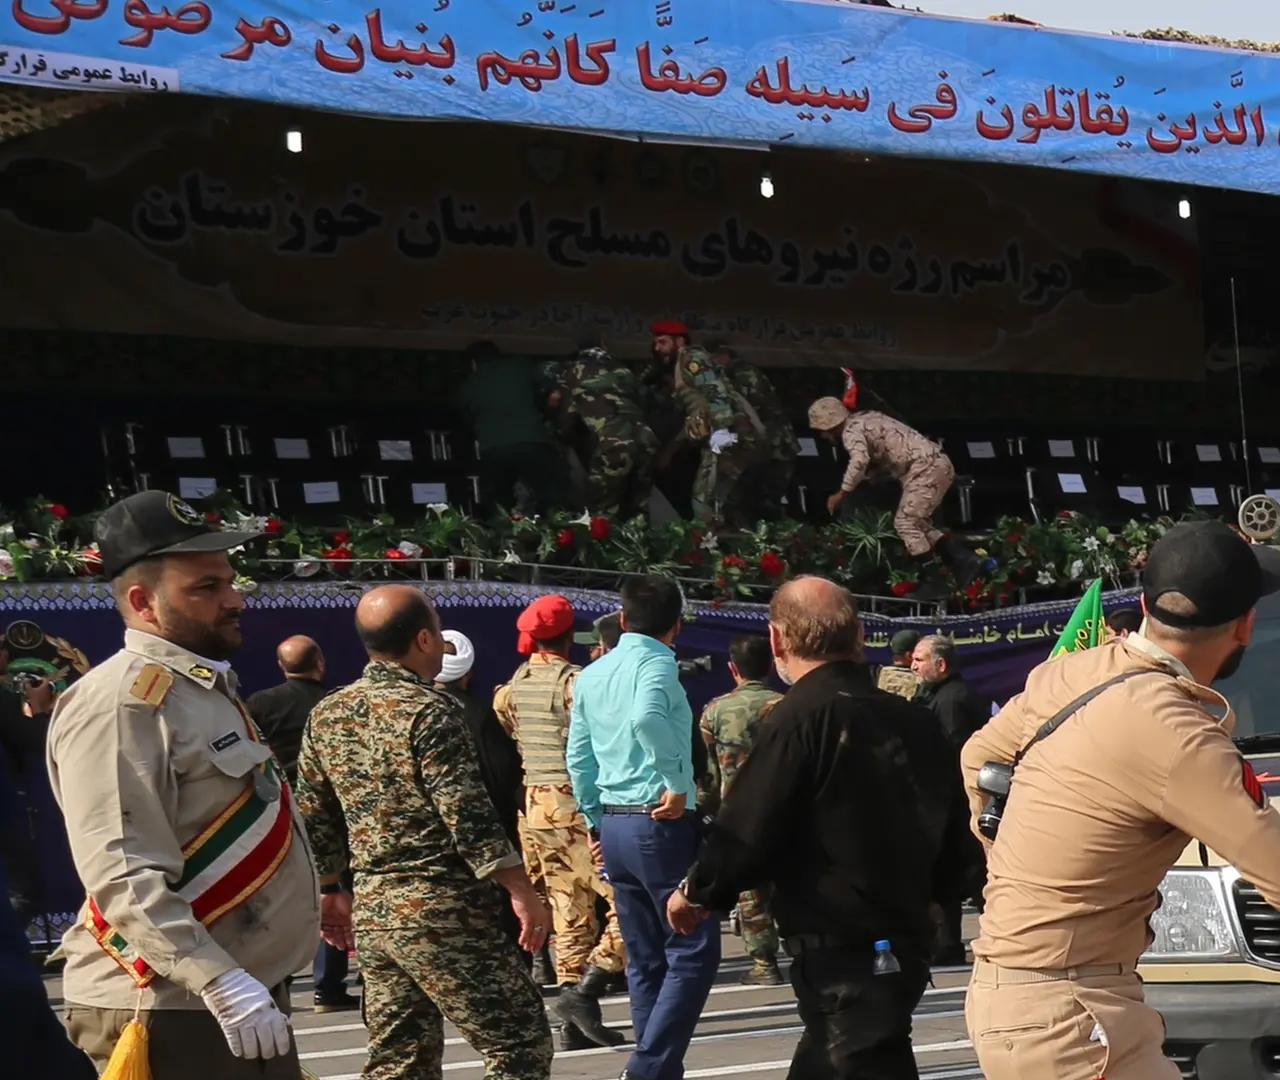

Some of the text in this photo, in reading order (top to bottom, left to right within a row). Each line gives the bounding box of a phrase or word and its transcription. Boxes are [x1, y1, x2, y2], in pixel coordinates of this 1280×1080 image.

[133, 170, 1069, 302] مراسم رژه نیروهای مسلح استان خوزستان
